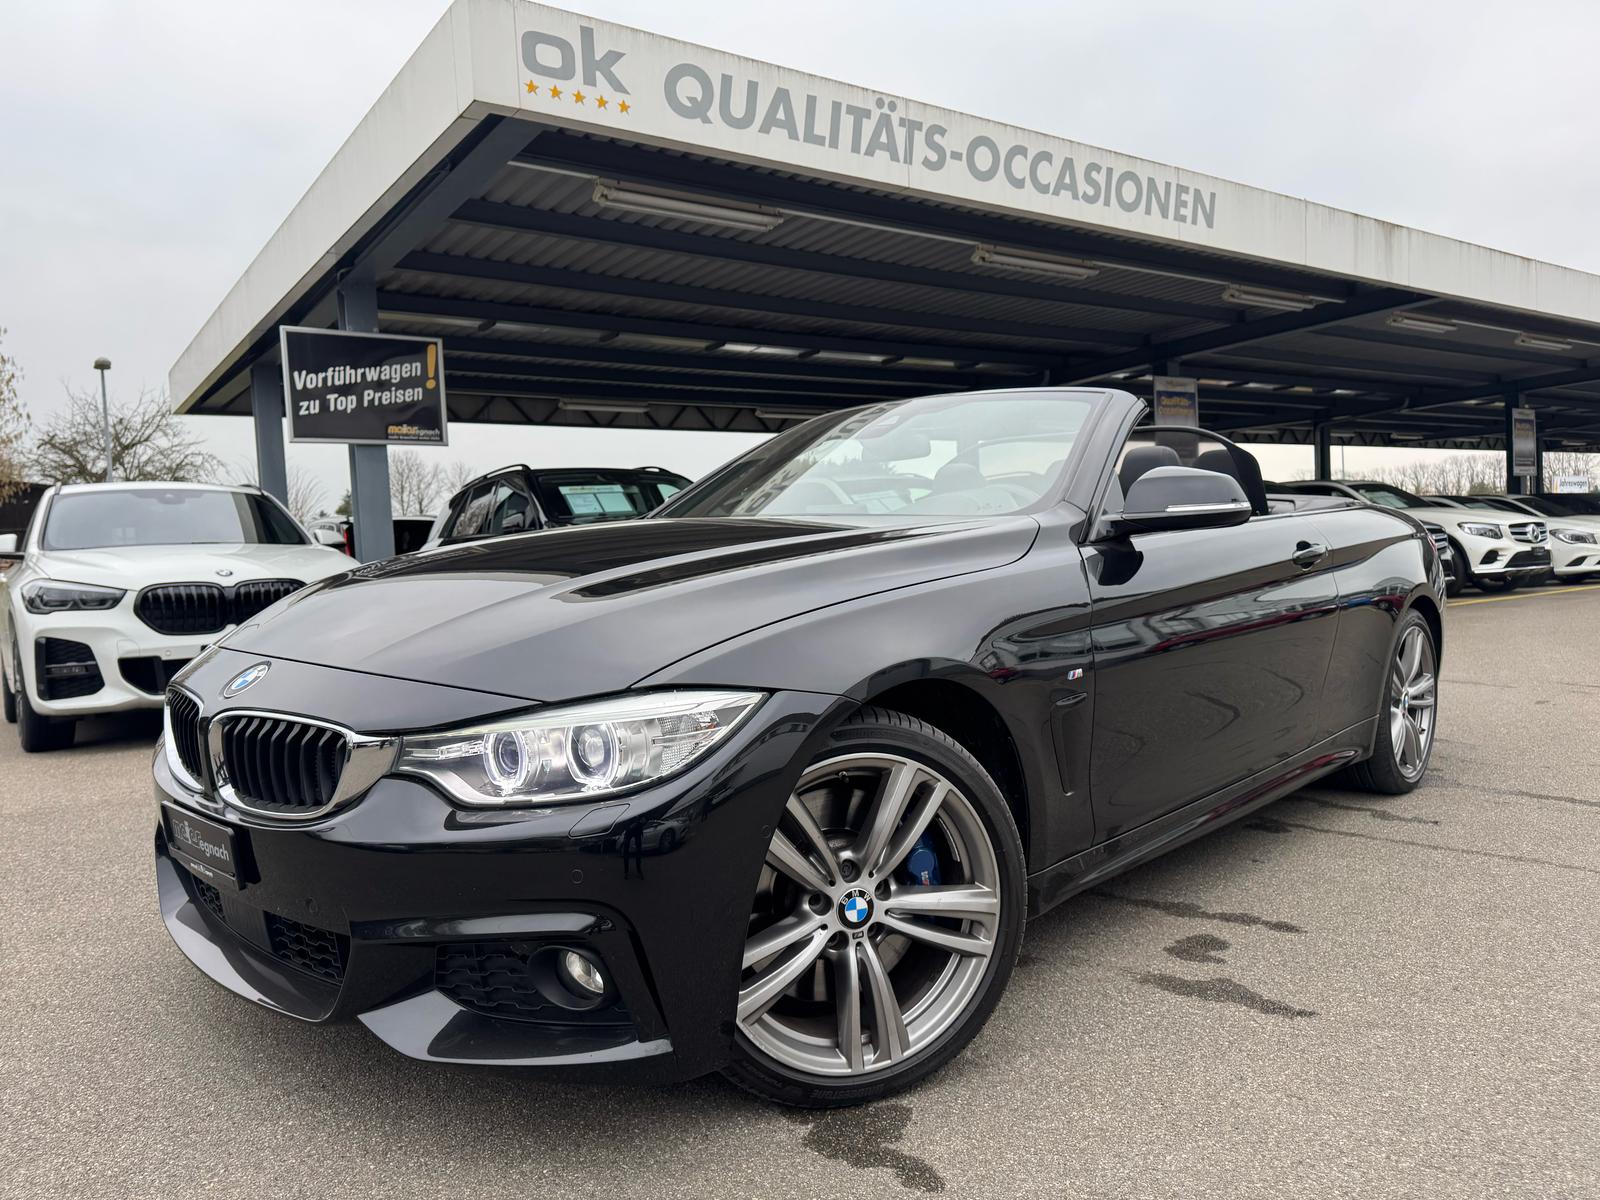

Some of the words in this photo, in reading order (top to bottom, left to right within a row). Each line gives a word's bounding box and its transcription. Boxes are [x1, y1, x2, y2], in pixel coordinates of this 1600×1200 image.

[521, 25, 631, 96] ok
[664, 62, 1217, 230] QUALITÄTS-OCCASIONEN
[293, 361, 421, 390] Vorführwagen
[299, 400, 320, 415] zu
[326, 393, 357, 414] Top
[363, 387, 423, 407] Preisen
[840, 889, 871, 905] BMW
